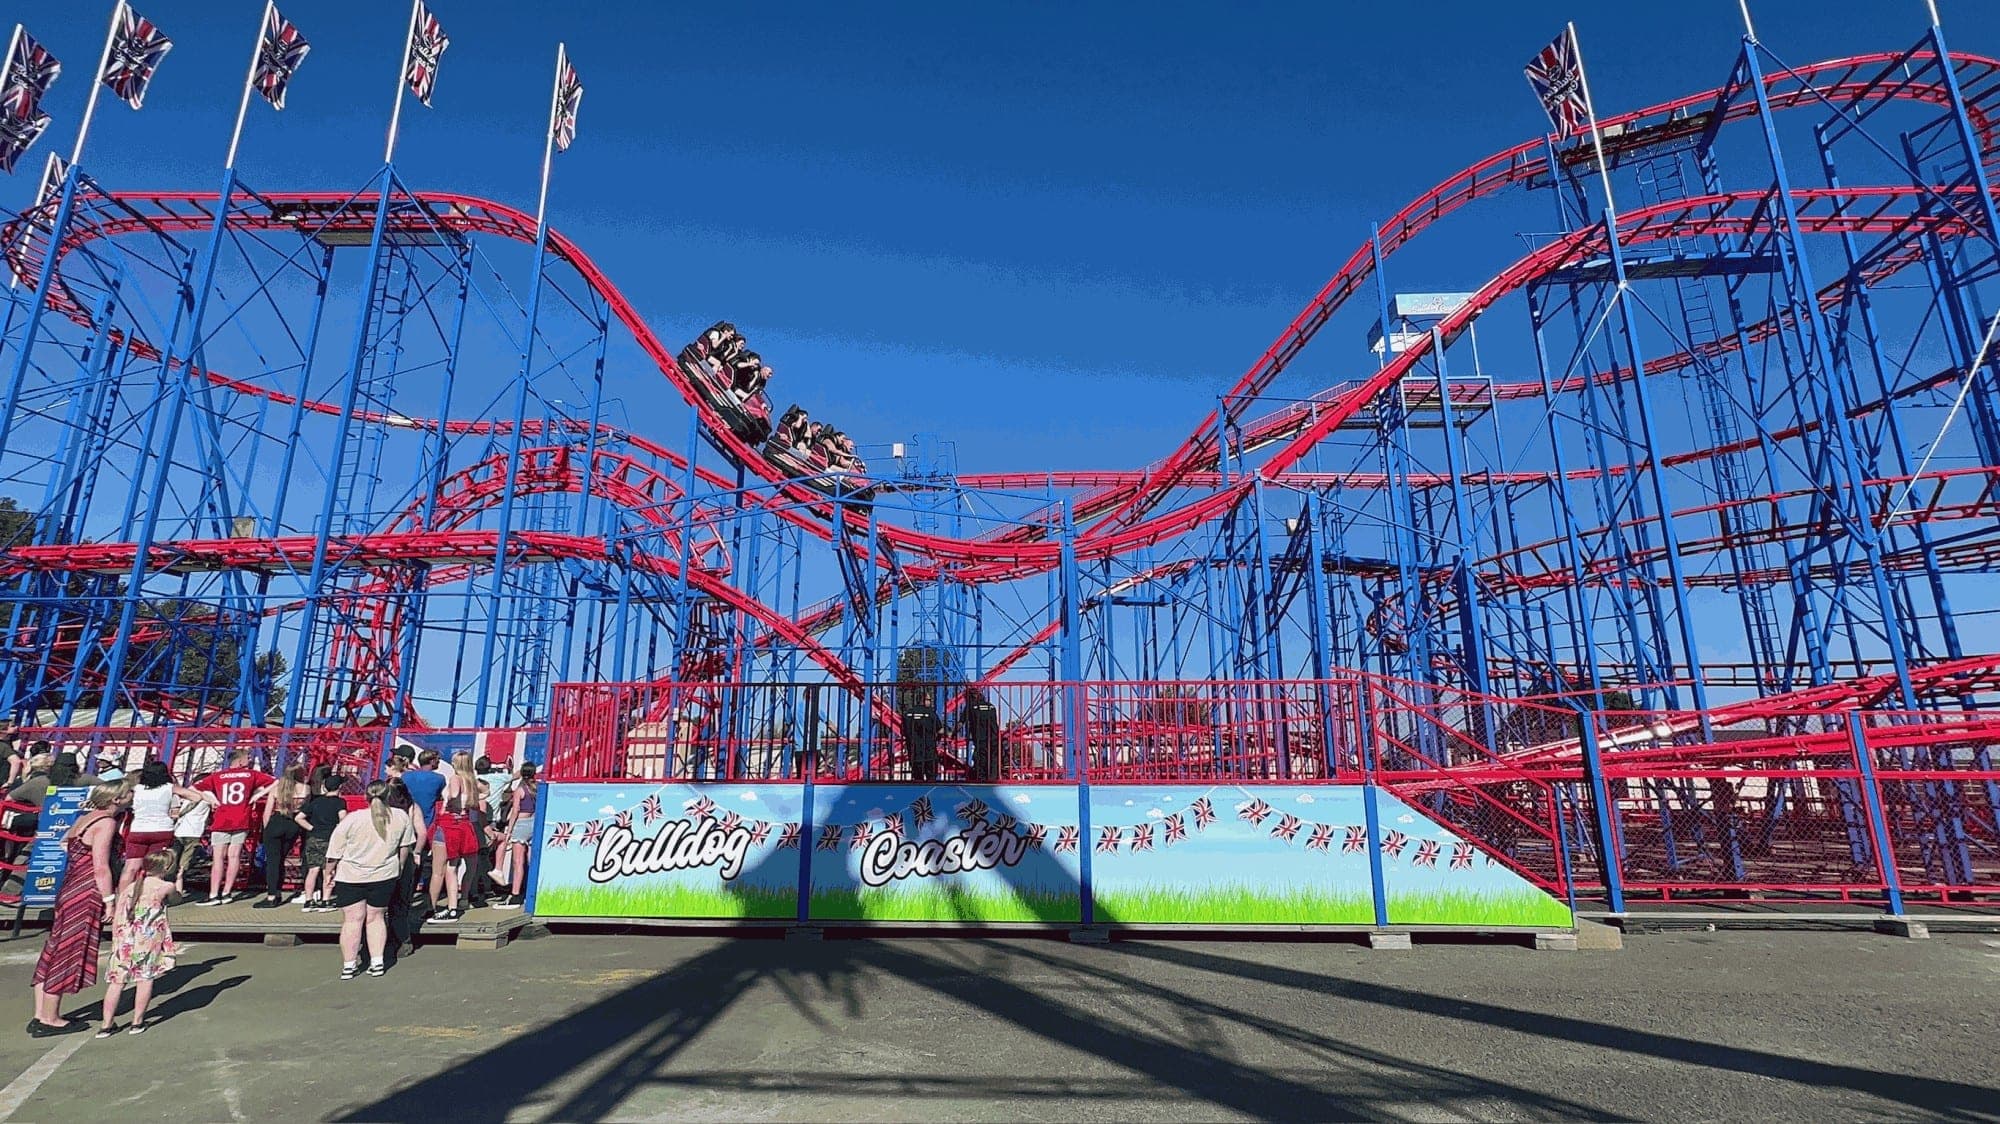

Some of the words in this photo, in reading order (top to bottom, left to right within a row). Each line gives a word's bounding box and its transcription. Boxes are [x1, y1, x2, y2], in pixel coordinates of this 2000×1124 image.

[222, 782, 245, 804] 18
[589, 816, 751, 883] Bulldog
[861, 818, 1028, 887] Coaster
